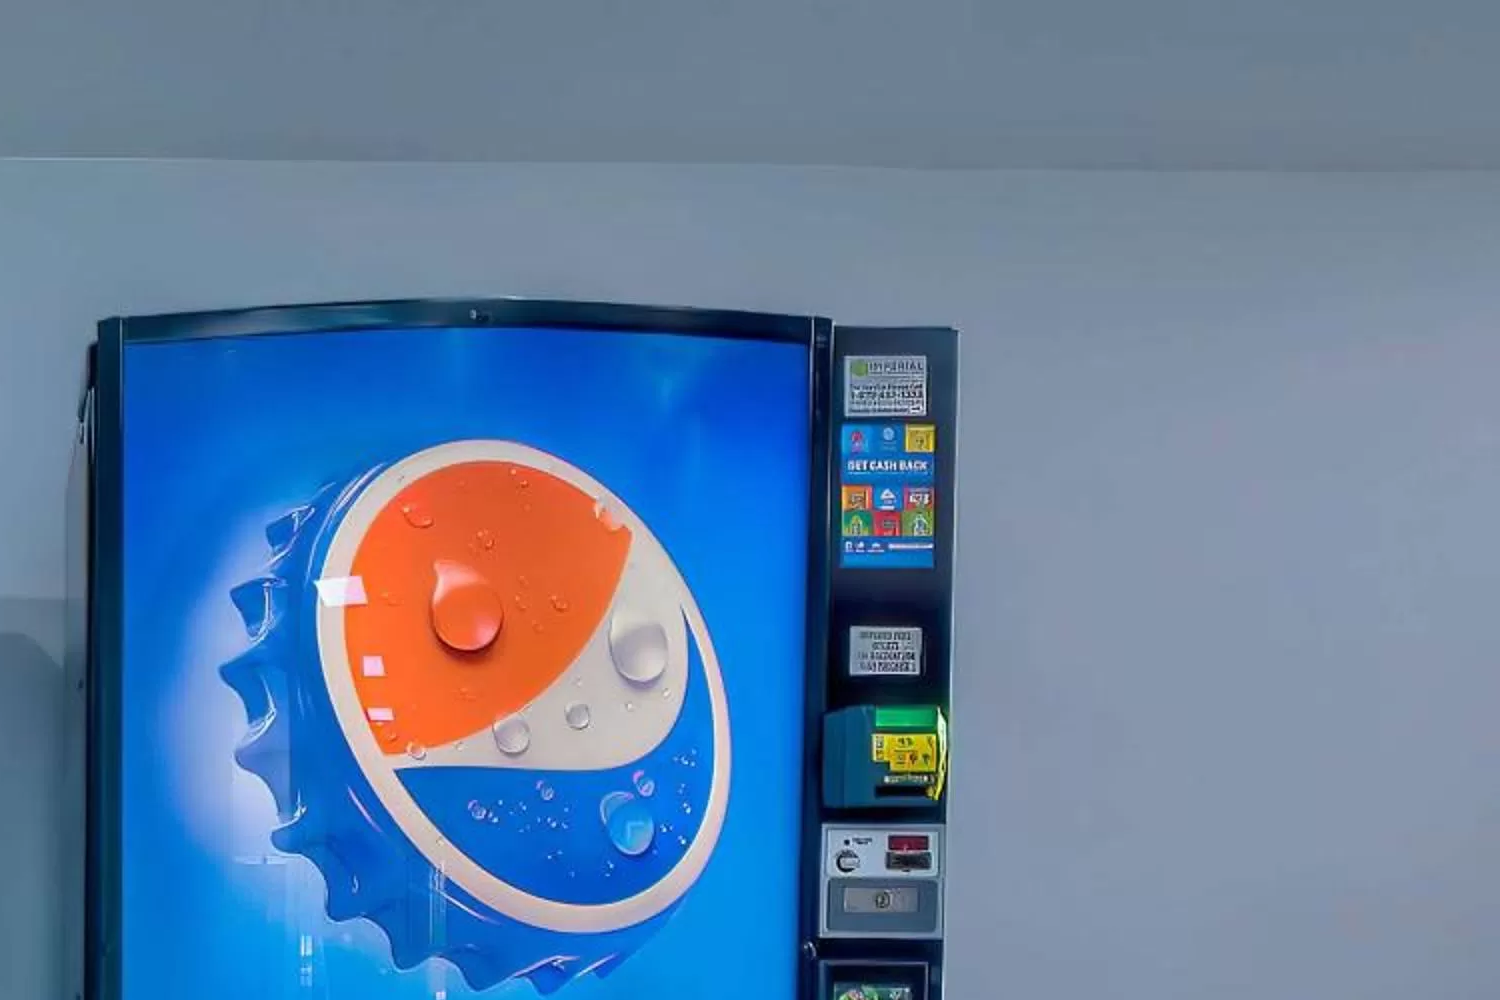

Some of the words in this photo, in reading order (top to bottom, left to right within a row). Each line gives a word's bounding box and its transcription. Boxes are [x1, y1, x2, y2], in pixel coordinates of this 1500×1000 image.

[847, 459, 870, 472] GET
[871, 460, 897, 472] CASH
[899, 460, 928, 472] BACK
